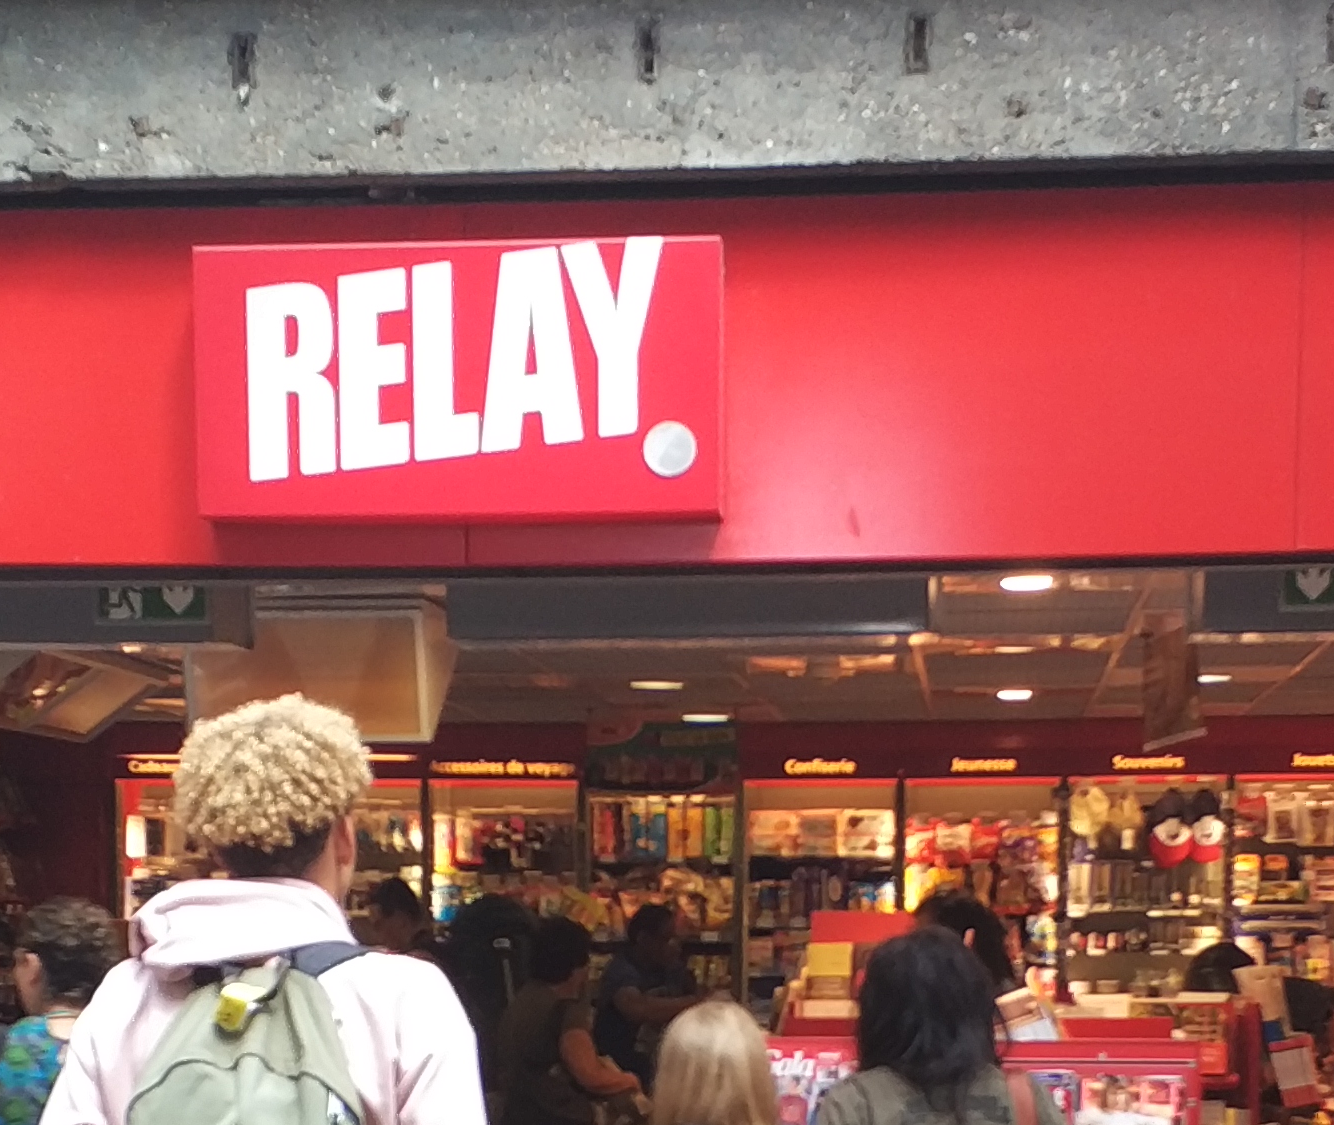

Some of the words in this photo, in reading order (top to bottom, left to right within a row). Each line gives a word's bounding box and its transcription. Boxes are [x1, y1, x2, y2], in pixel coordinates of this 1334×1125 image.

[784, 758, 857, 775] Confiserie
[950, 757, 1018, 772] Jeunesse
[1112, 754, 1185, 770] Souvenirs
